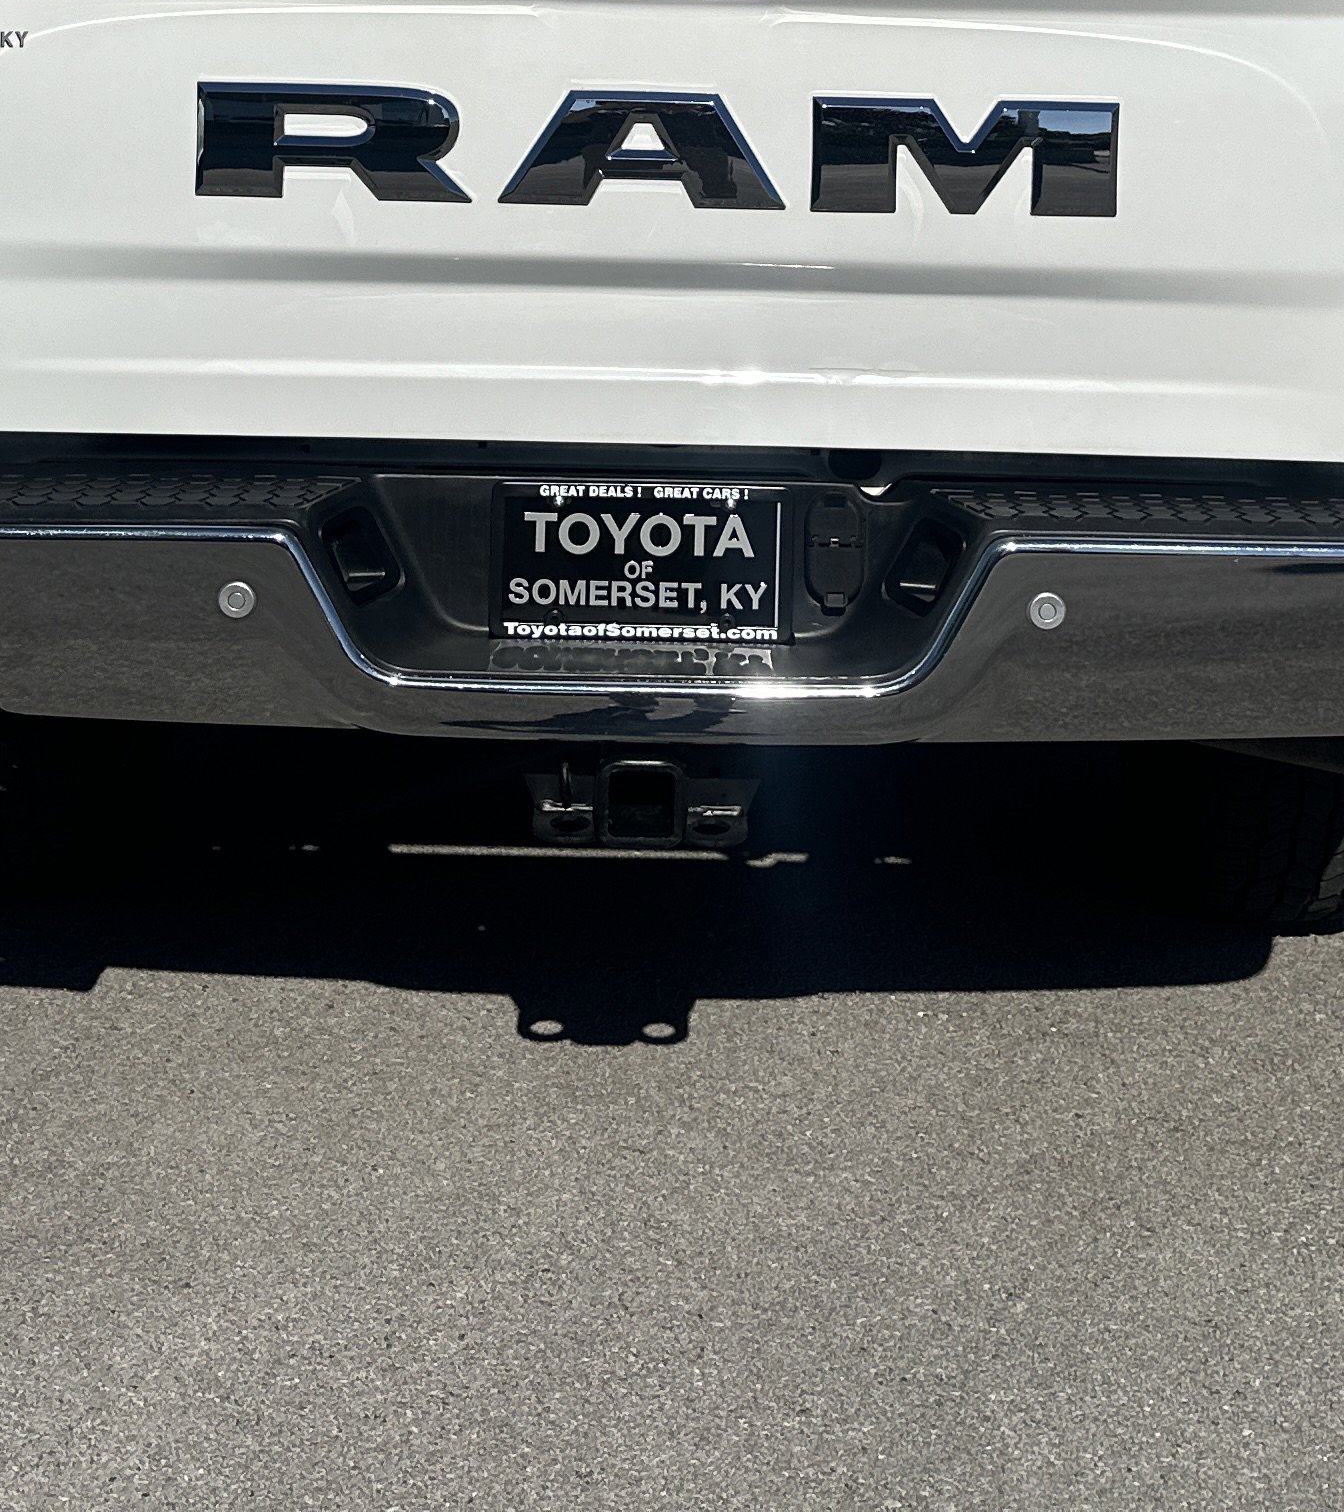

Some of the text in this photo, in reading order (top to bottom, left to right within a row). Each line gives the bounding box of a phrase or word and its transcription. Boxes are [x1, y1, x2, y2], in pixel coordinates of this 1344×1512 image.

[0, 30, 29, 48] KY
[195, 81, 1119, 217] RAM
[539, 484, 586, 497] GREAT
[653, 486, 699, 499] GREAT
[524, 511, 755, 558] TOYOTA
[624, 560, 654, 579] OF
[508, 578, 768, 614] SOMERSET, KY
[503, 621, 778, 640] ToyotaofSomerset.com
